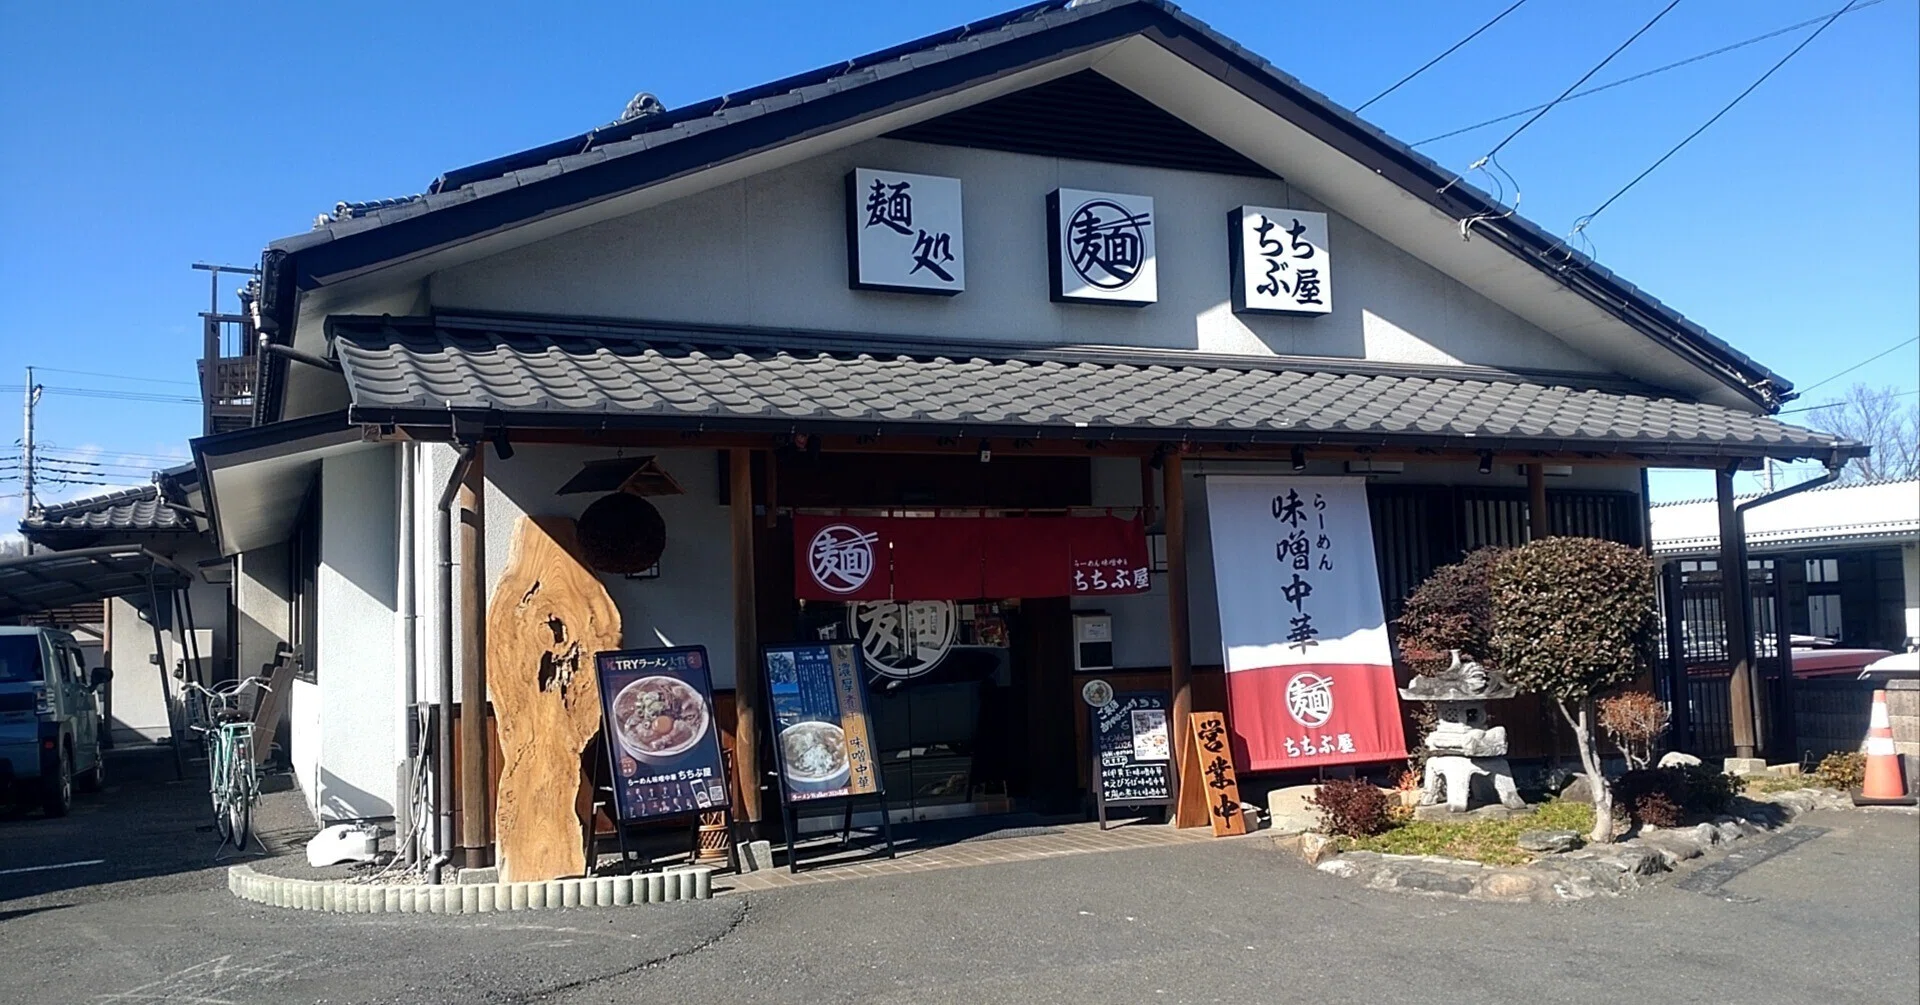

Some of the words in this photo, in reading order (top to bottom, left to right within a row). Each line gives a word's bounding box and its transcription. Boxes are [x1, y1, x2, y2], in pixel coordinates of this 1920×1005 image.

[865, 178, 956, 282] 麺処
[1070, 205, 1143, 287] 麺
[812, 529, 873, 591] 麺
[1271, 487, 1320, 655] 味噌中華
[1312, 493, 1334, 571] らーめん
[1073, 566, 1150, 591] ちちぶ屋
[1286, 674, 1333, 726] 麺
[1197, 718, 1241, 830] 営業中
[1283, 733, 1357, 758] ちちぶ屋
